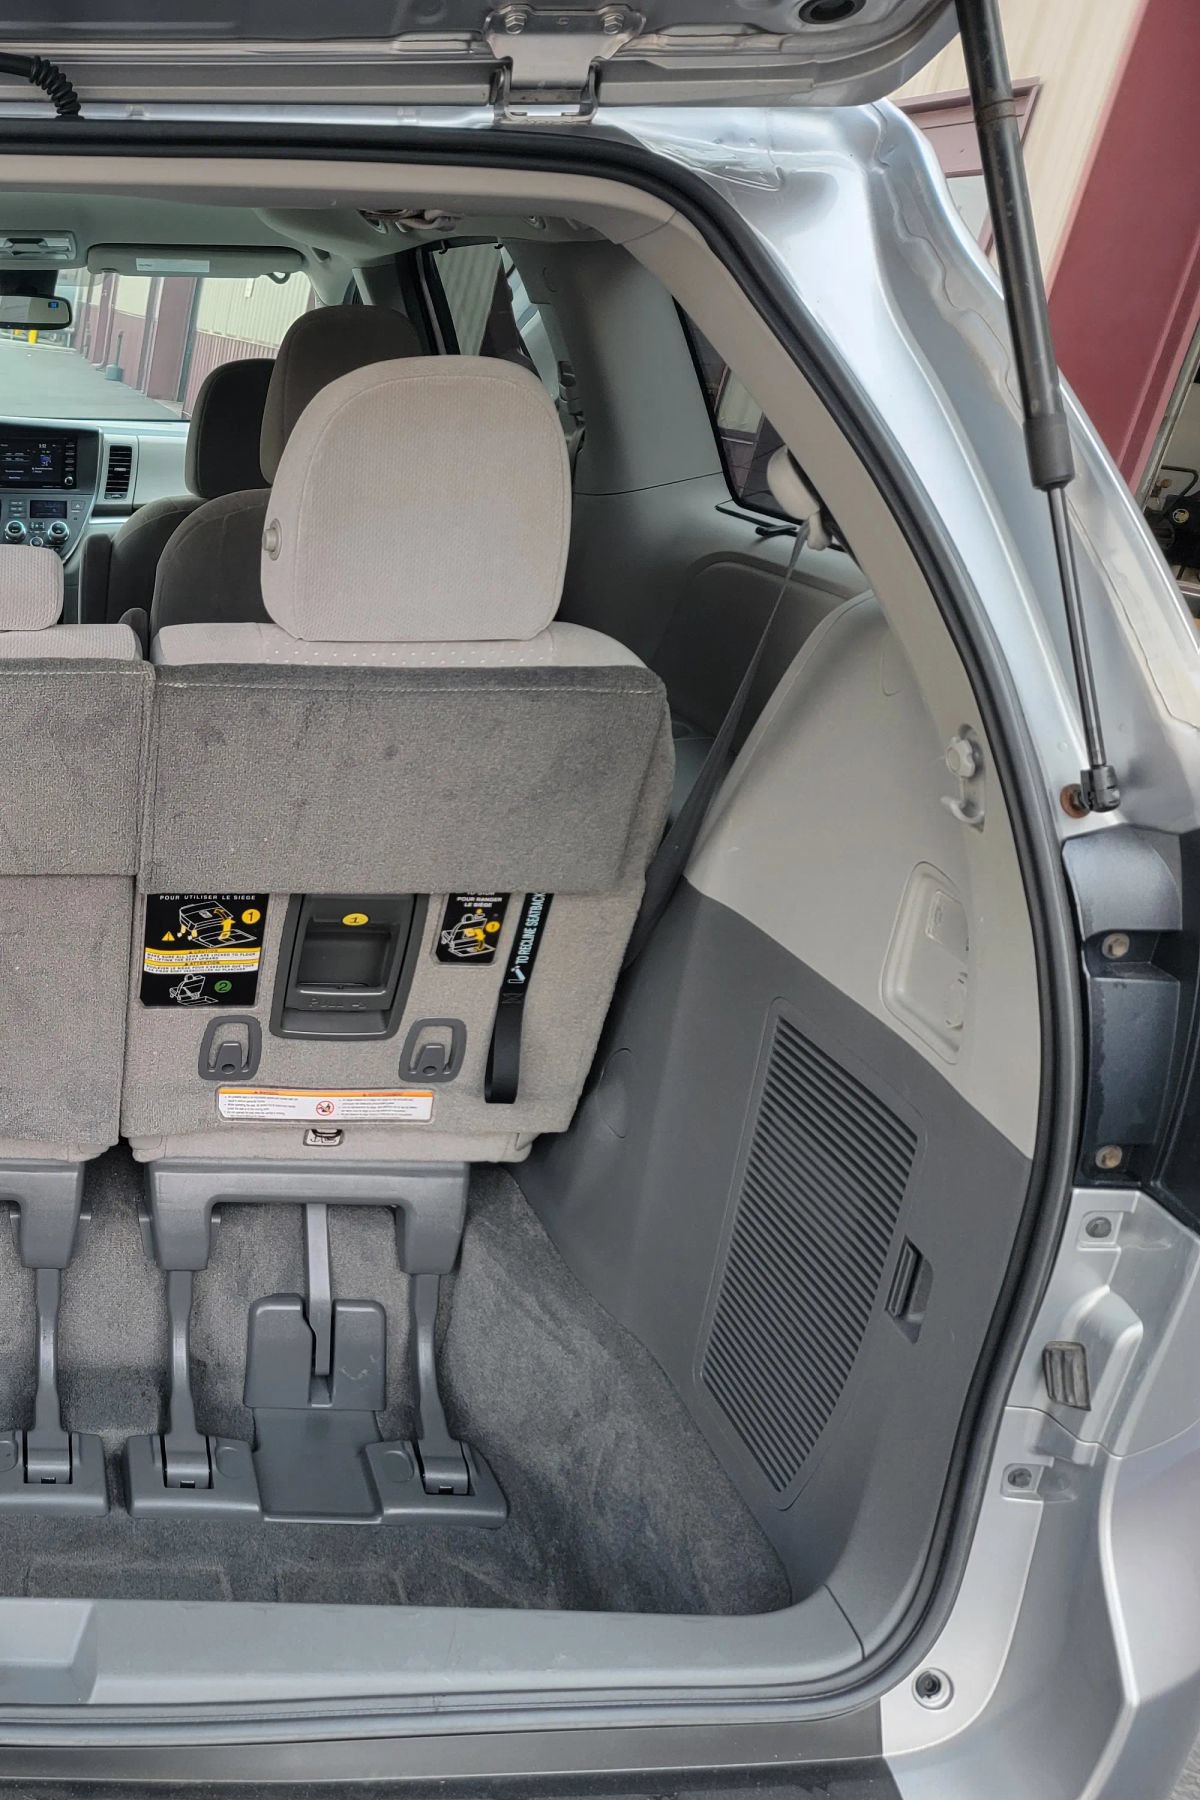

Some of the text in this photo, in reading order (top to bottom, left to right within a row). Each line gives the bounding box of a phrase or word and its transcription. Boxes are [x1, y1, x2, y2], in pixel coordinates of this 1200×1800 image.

[515, 892, 546, 965] TO RECLINE SEATBACK
